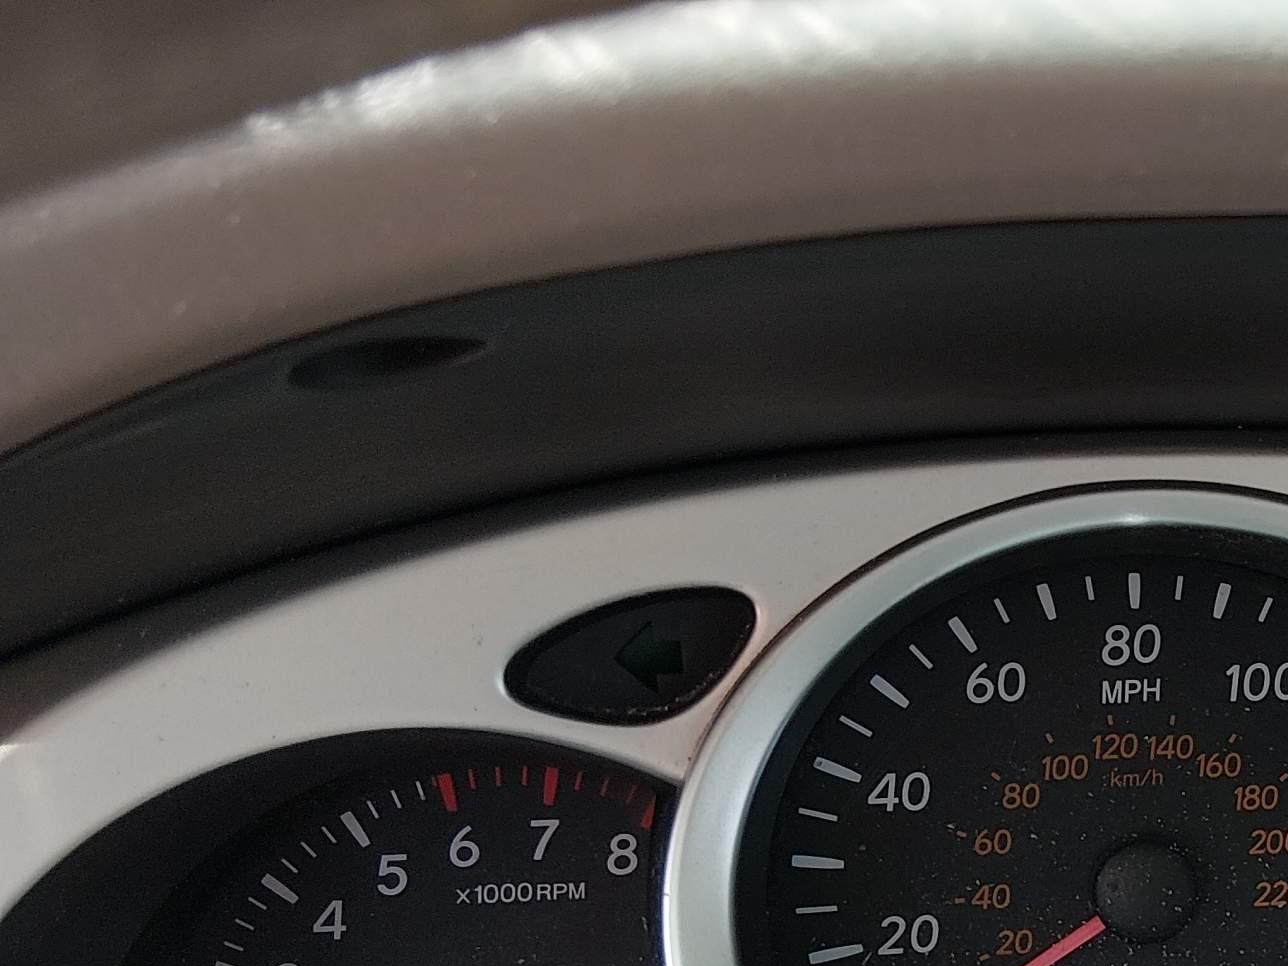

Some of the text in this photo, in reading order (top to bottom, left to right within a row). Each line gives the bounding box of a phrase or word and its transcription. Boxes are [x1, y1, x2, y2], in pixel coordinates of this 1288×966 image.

[1101, 624, 1162, 666] 80
[966, 662, 1026, 704] 60
[1102, 680, 1161, 704] MPH
[1092, 734, 1138, 760] 120
[1147, 734, 1194, 760] 140
[1042, 754, 1089, 781] 100
[1109, 767, 1164, 788] km/h
[1198, 751, 1241, 778] 160
[867, 771, 931, 812] 40
[1002, 783, 1040, 808] 80
[1233, 784, 1279, 811] 180
[449, 825, 480, 868] 6
[530, 819, 559, 861] 7
[974, 829, 1012, 856] 60
[606, 833, 638, 876] 8
[377, 854, 408, 896] 5
[536, 882, 587, 901] RPM
[971, 884, 1011, 910] 40
[312, 900, 347, 940] 4
[877, 914, 940, 956] 20
[996, 930, 1033, 956] 20
